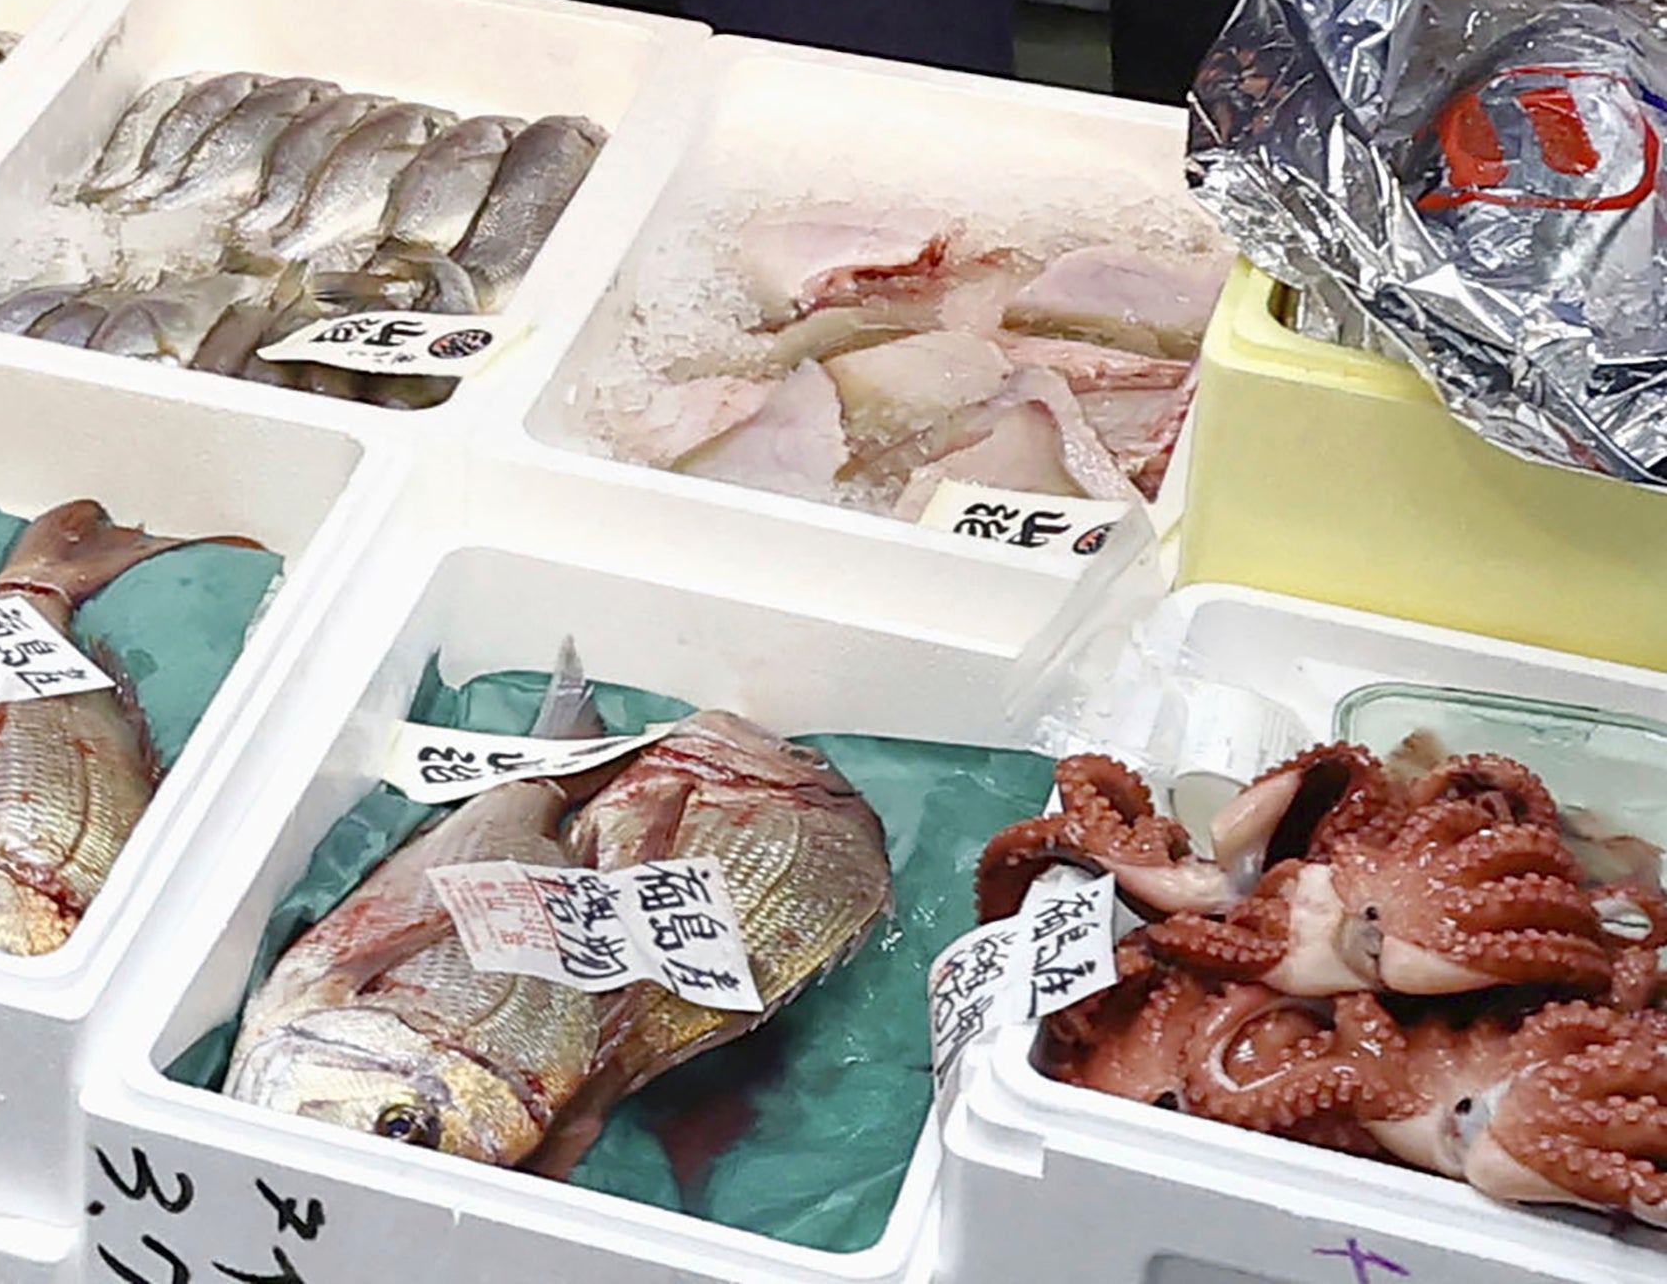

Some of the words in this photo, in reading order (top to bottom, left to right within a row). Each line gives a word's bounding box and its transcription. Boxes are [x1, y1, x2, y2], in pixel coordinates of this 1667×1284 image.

[630, 861, 751, 1011] 福島産
[1025, 889, 1099, 1019] 福島産
